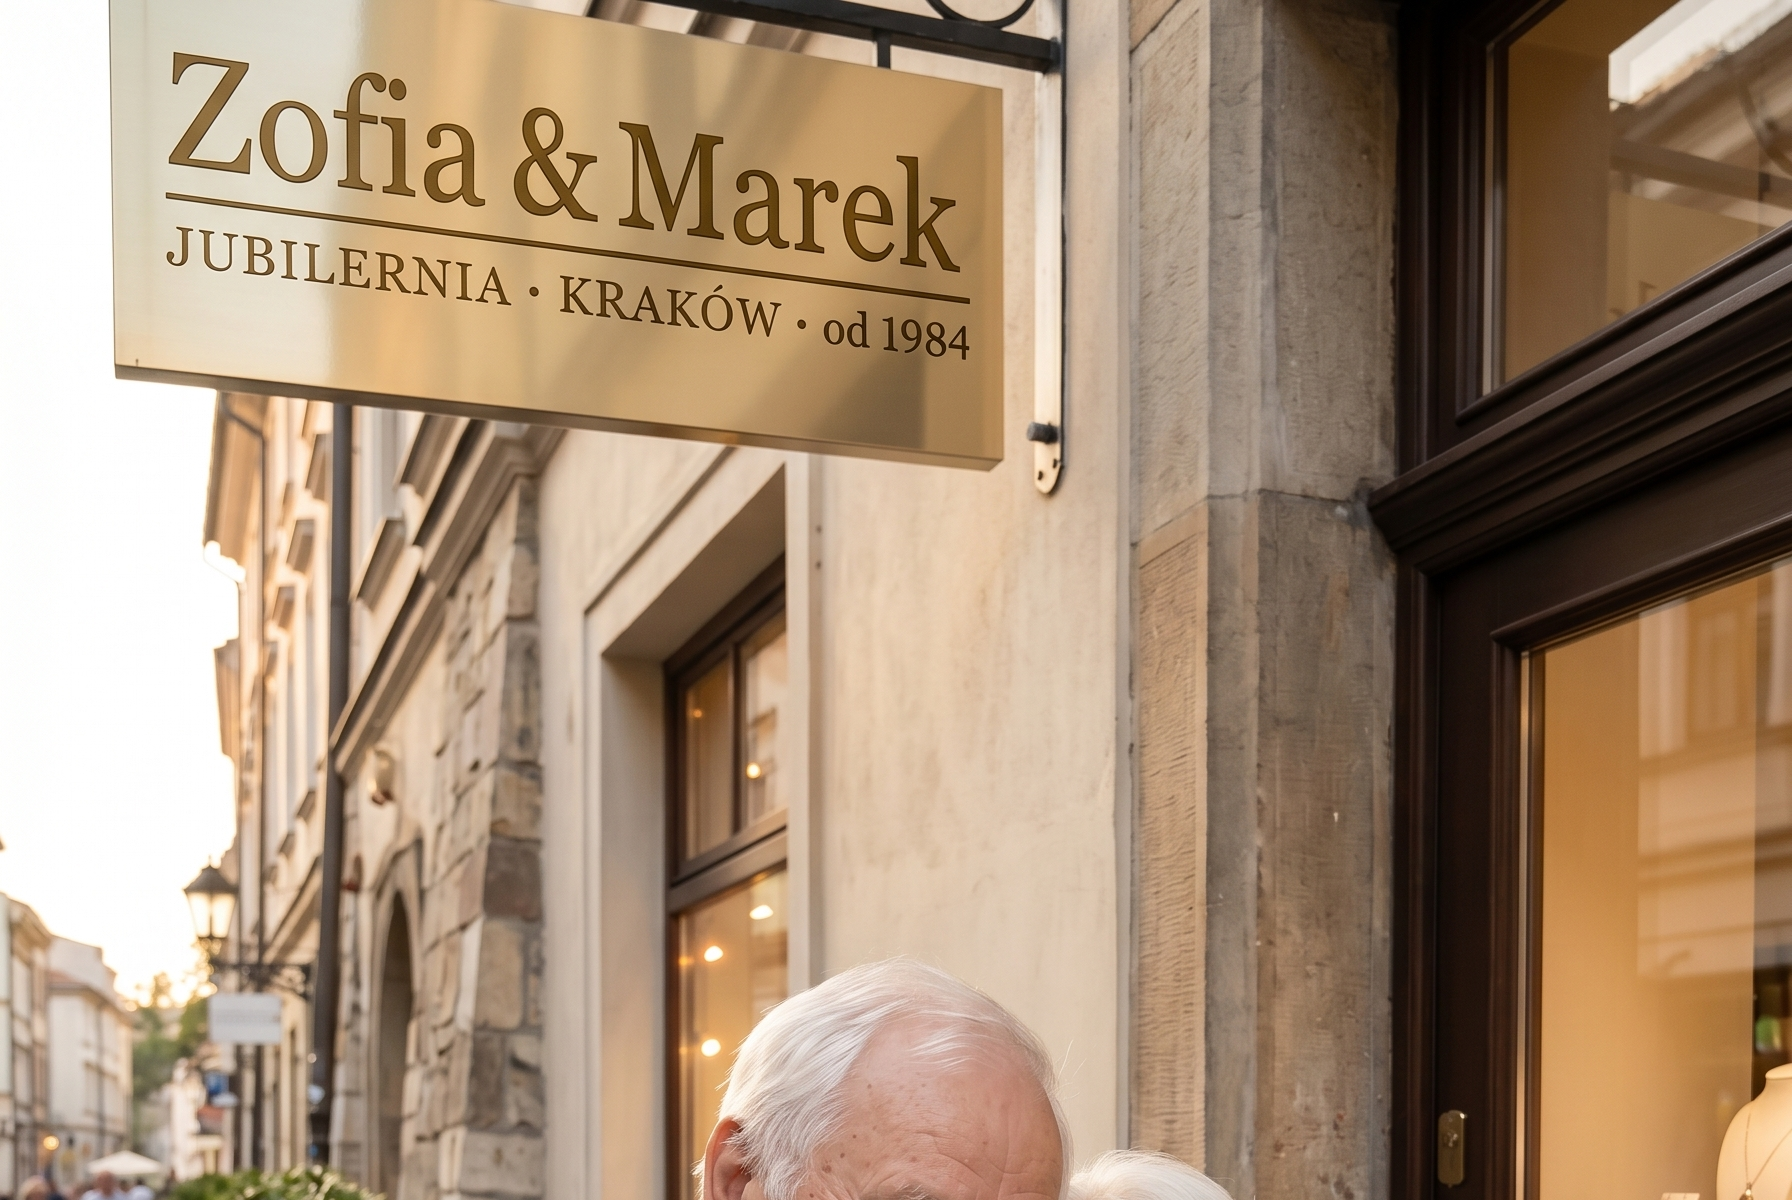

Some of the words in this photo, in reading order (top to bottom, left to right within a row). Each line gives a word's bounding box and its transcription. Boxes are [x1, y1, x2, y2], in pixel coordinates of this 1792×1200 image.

[168, 52, 486, 208] Zofia
[513, 106, 599, 223] &
[618, 121, 961, 274] Marek
[166, 226, 513, 307] JUBILERNIA
[559, 274, 783, 338] KRAKÓW
[823, 311, 871, 349] od
[881, 317, 970, 361] 1984
